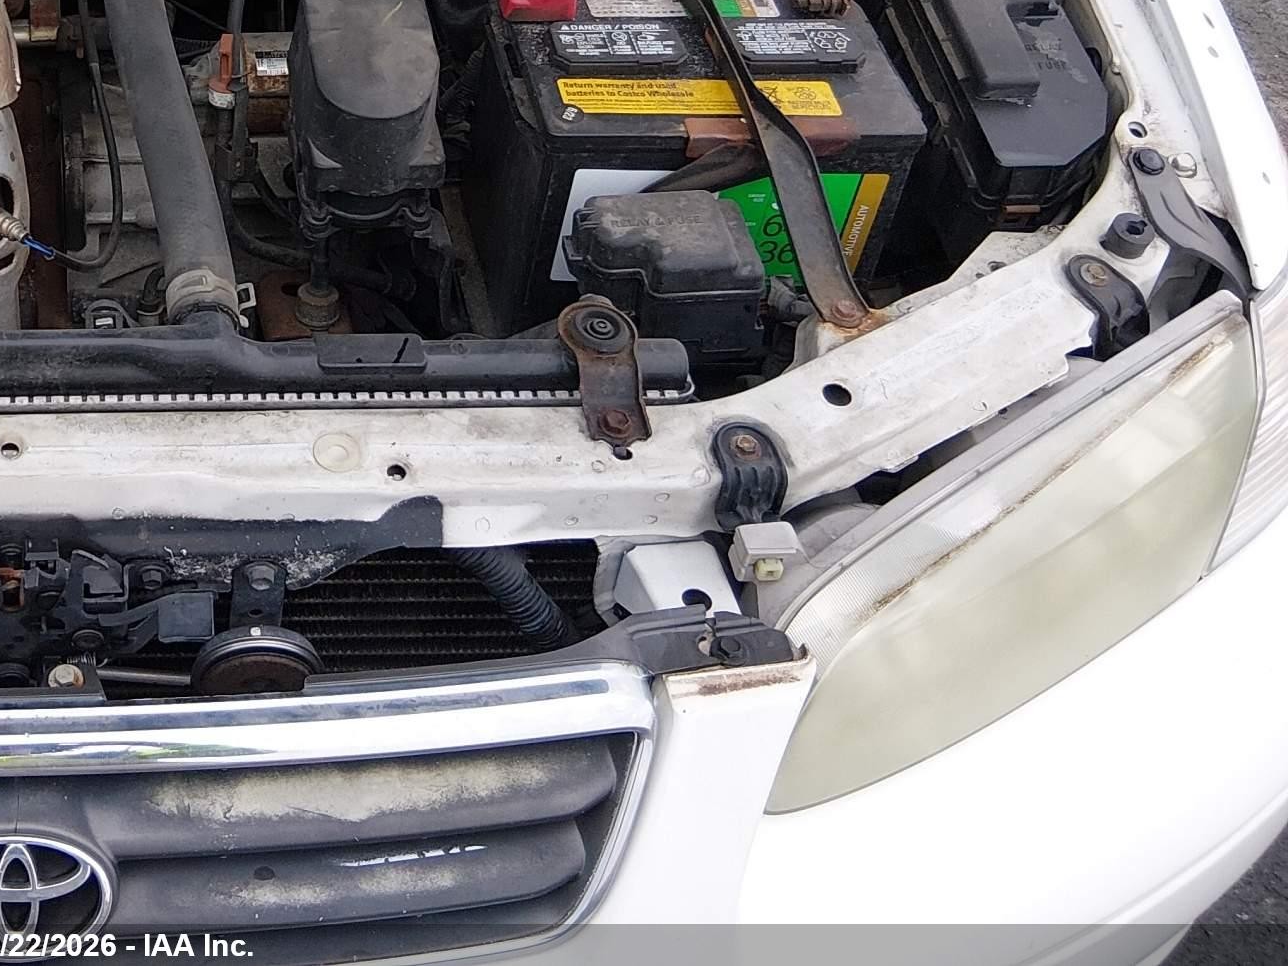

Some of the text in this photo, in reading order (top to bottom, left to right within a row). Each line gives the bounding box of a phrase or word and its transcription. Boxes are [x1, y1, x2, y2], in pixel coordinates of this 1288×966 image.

[571, 23, 612, 31] DANGER
[621, 23, 660, 31] POISON
[562, 81, 593, 89] Return
[636, 81, 653, 89] and
[842, 204, 870, 257] AUTOMOTIVE
